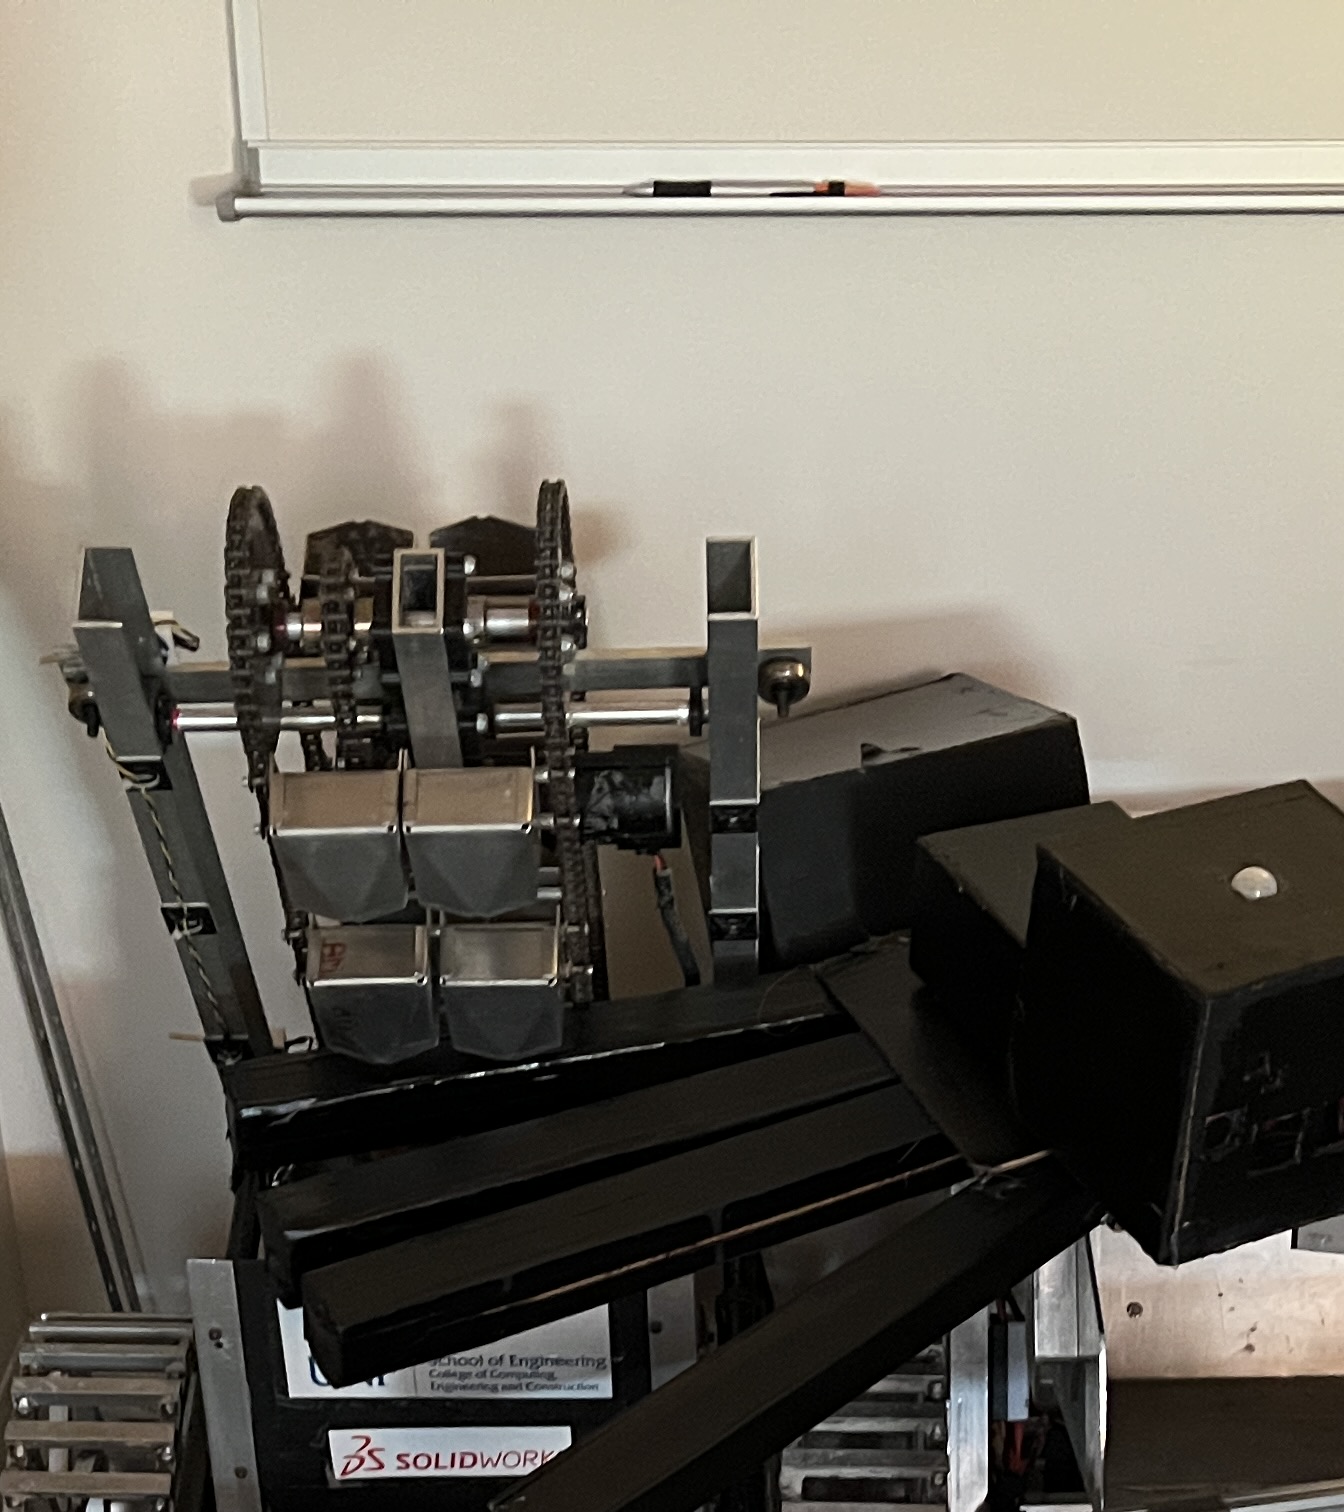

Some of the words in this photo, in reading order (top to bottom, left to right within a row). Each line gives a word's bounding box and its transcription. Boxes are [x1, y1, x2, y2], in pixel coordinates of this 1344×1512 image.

[487, 1354, 506, 1368] of
[509, 1354, 609, 1370] Engineering
[428, 1368, 473, 1382] College
[475, 1368, 487, 1379] of
[430, 1380, 499, 1393] Engineering
[502, 1381, 522, 1391] and
[525, 1380, 600, 1392] Construction
[395, 1449, 555, 1471] SOLIDWORK
